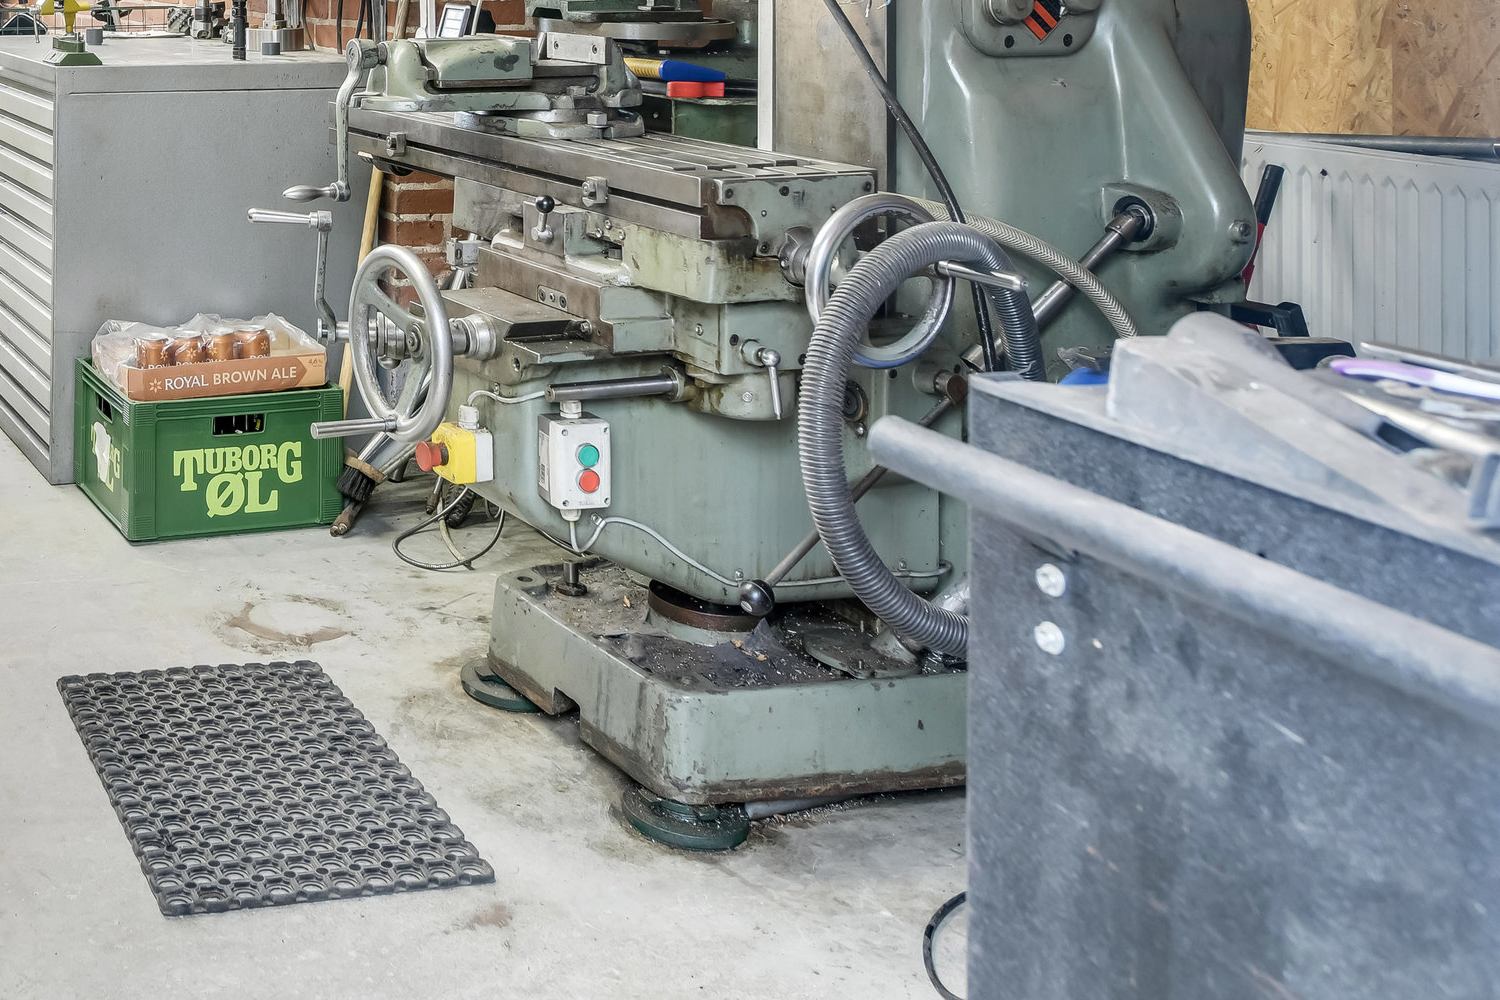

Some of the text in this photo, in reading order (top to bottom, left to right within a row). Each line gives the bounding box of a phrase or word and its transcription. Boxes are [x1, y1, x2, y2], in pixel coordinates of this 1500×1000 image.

[165, 366, 297, 391] ROYAL BROWN ALE
[173, 441, 303, 493] TUBORG
[205, 471, 279, 519] ØL
